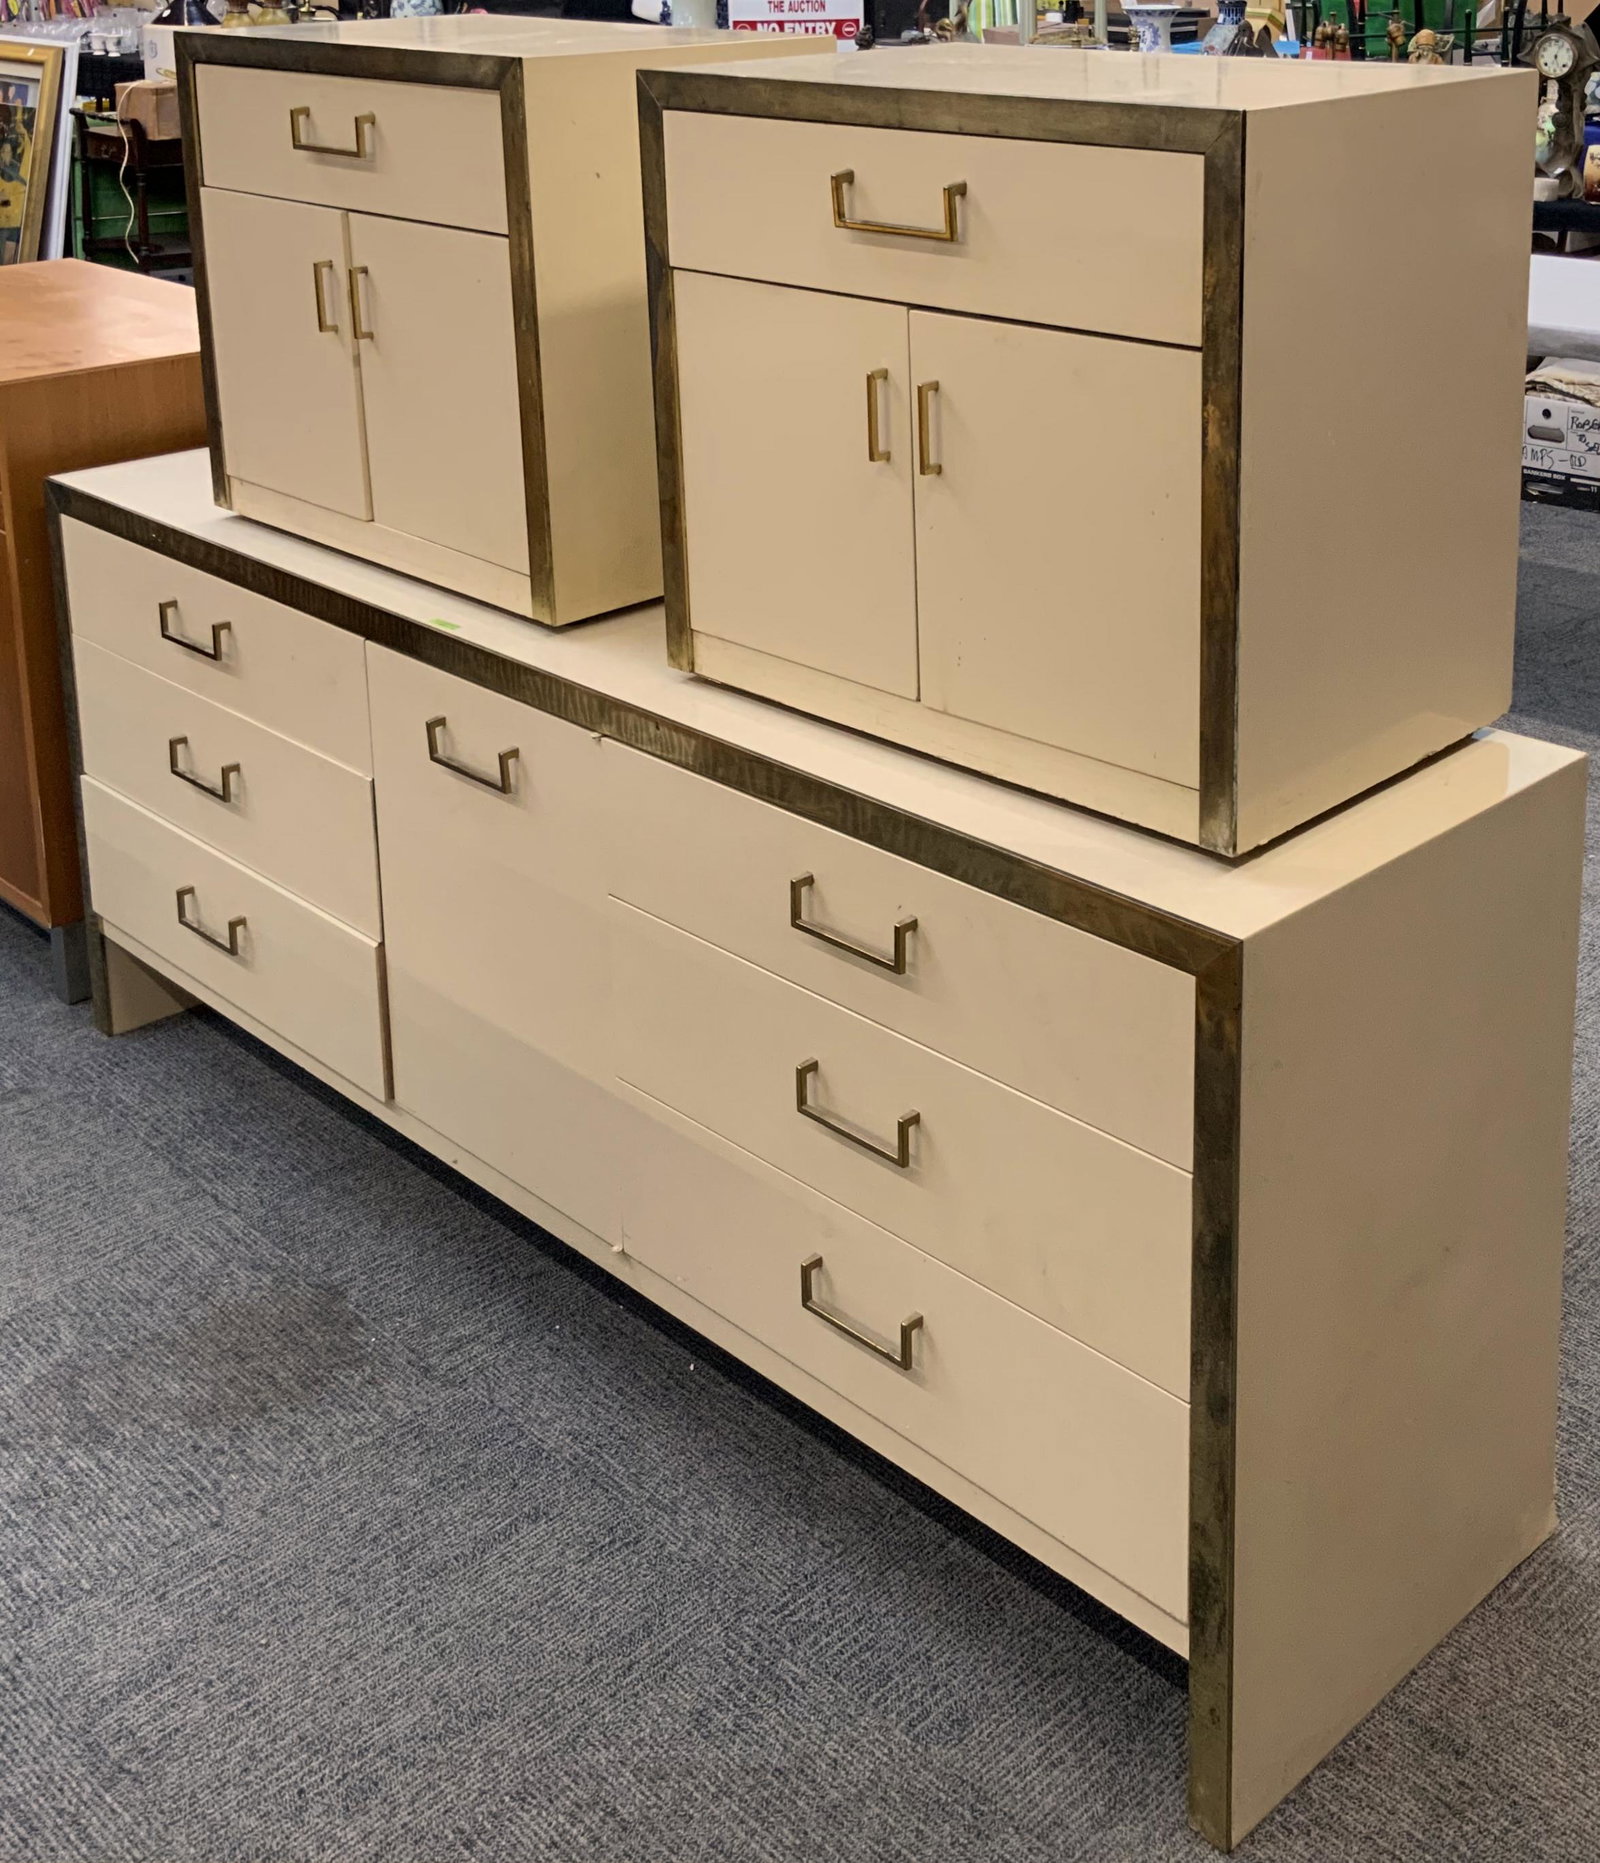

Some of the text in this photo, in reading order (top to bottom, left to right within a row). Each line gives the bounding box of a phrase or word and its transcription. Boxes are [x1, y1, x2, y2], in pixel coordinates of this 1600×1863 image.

[767, 0, 826, 13] THE AUCTION
[756, 22, 836, 36] NO ENTRY
